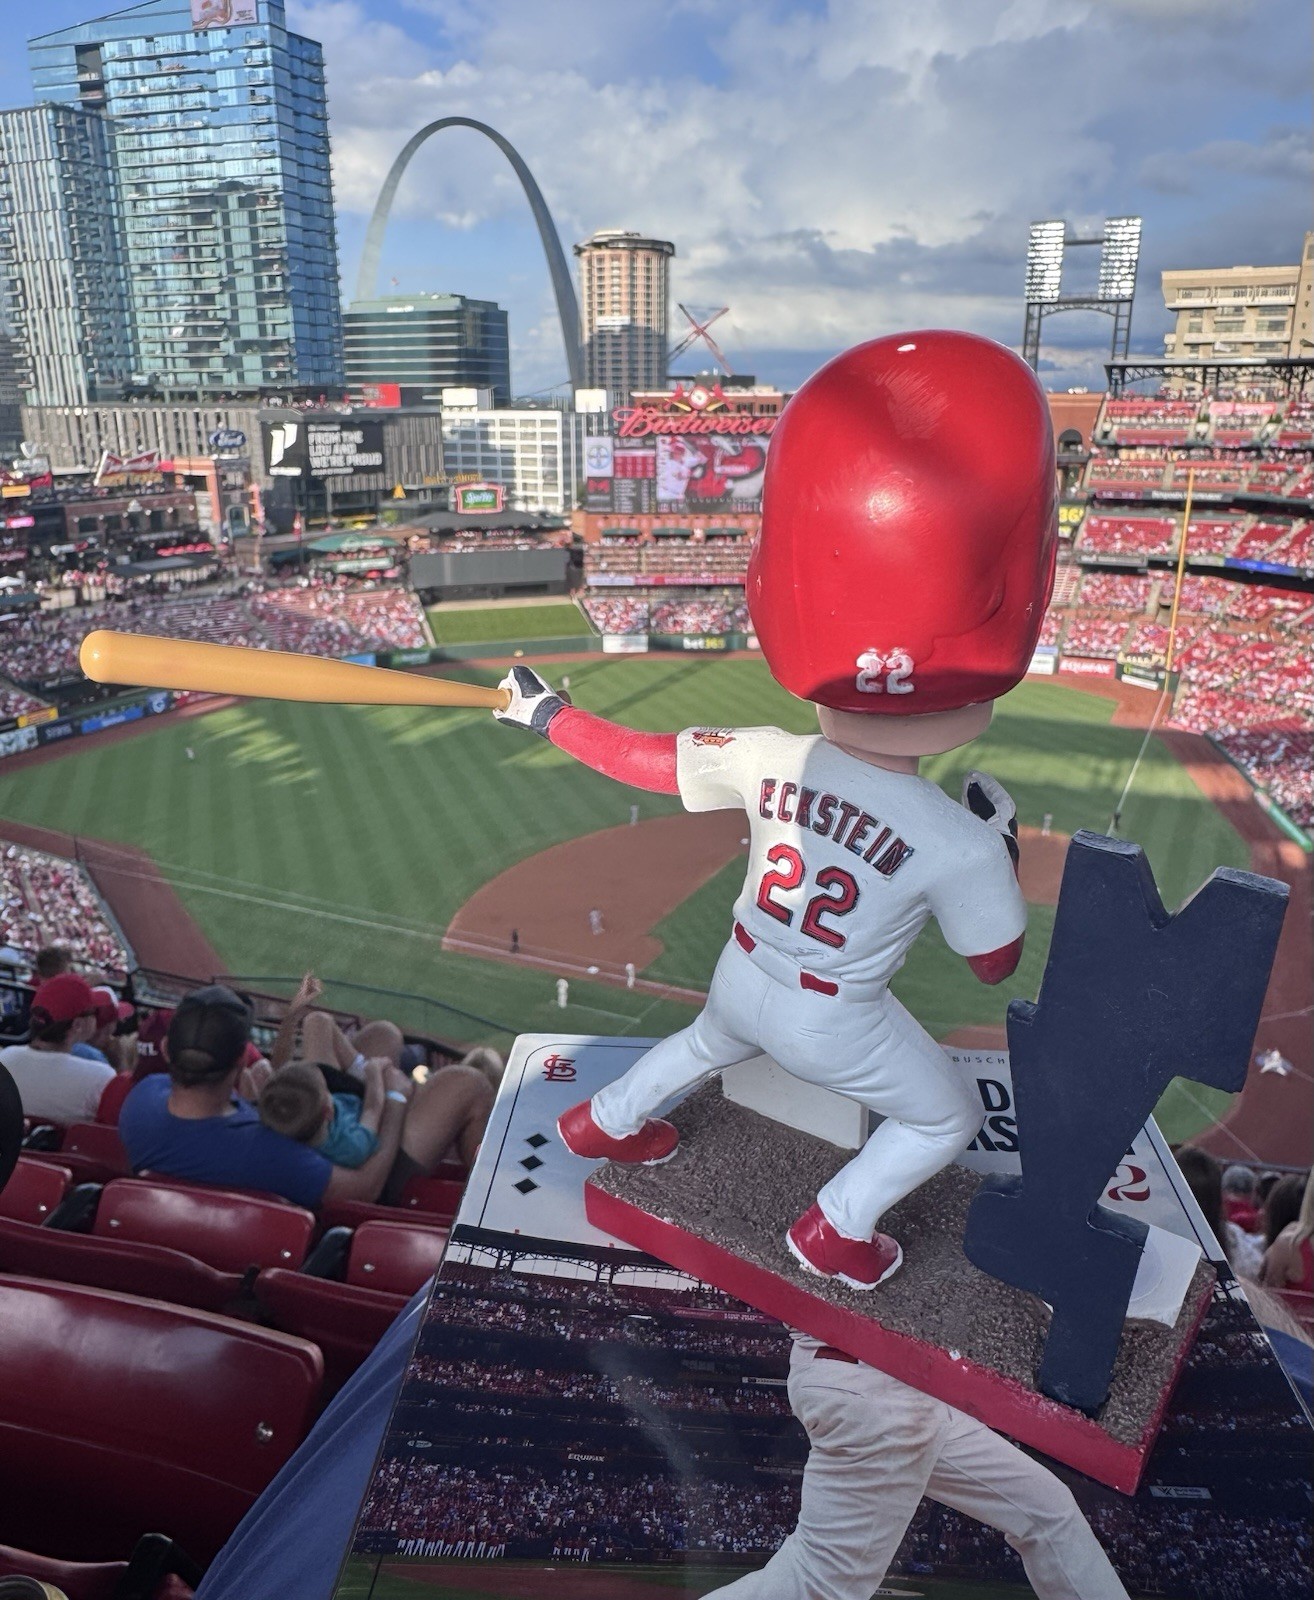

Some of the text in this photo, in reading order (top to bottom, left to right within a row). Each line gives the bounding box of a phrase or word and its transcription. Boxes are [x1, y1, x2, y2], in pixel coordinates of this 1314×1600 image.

[612, 406, 776, 437] Budweiser
[341, 430, 364, 444] THE
[683, 637, 726, 650] bet365
[856, 649, 915, 695] 22
[759, 778, 915, 877] ECKSTEIN
[757, 843, 861, 949] 22
[952, 1056, 1006, 1065] BUSCH
[567, 1452, 606, 1465] EQUIFAX
